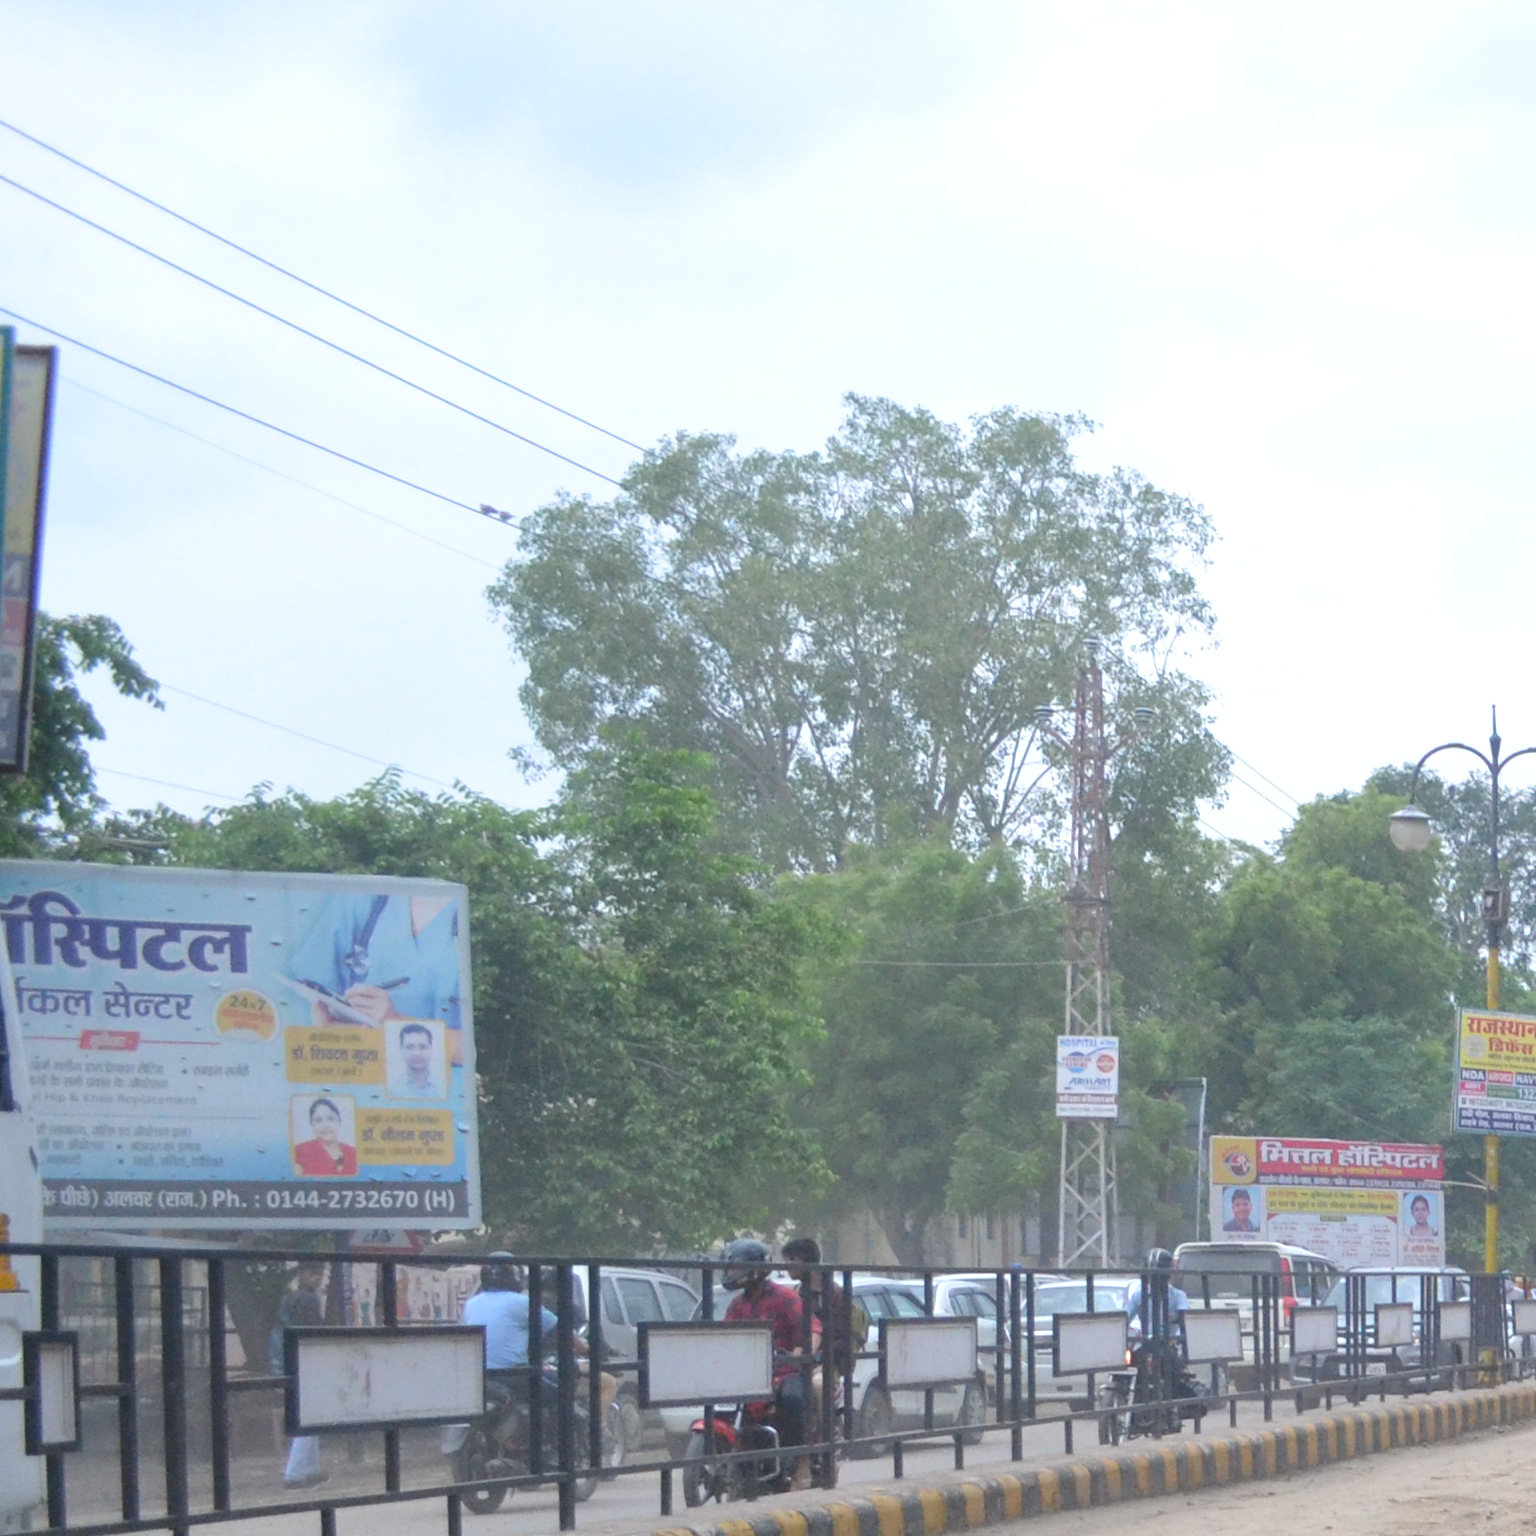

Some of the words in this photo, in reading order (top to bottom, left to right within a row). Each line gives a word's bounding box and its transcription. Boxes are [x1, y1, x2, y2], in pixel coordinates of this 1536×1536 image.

[103, 981, 194, 1020] सेन्टर
[1462, 1070, 1485, 1080] NDA
[1260, 1141, 1332, 1165] मित्तल
[1338, 1144, 1439, 1170] हॉस्पिटल
[104, 1191, 153, 1208] अलवर
[212, 1189, 247, 1208] Ph.
[266, 1190, 419, 1208] 0144-2732670
[424, 1190, 456, 1212] (H)
